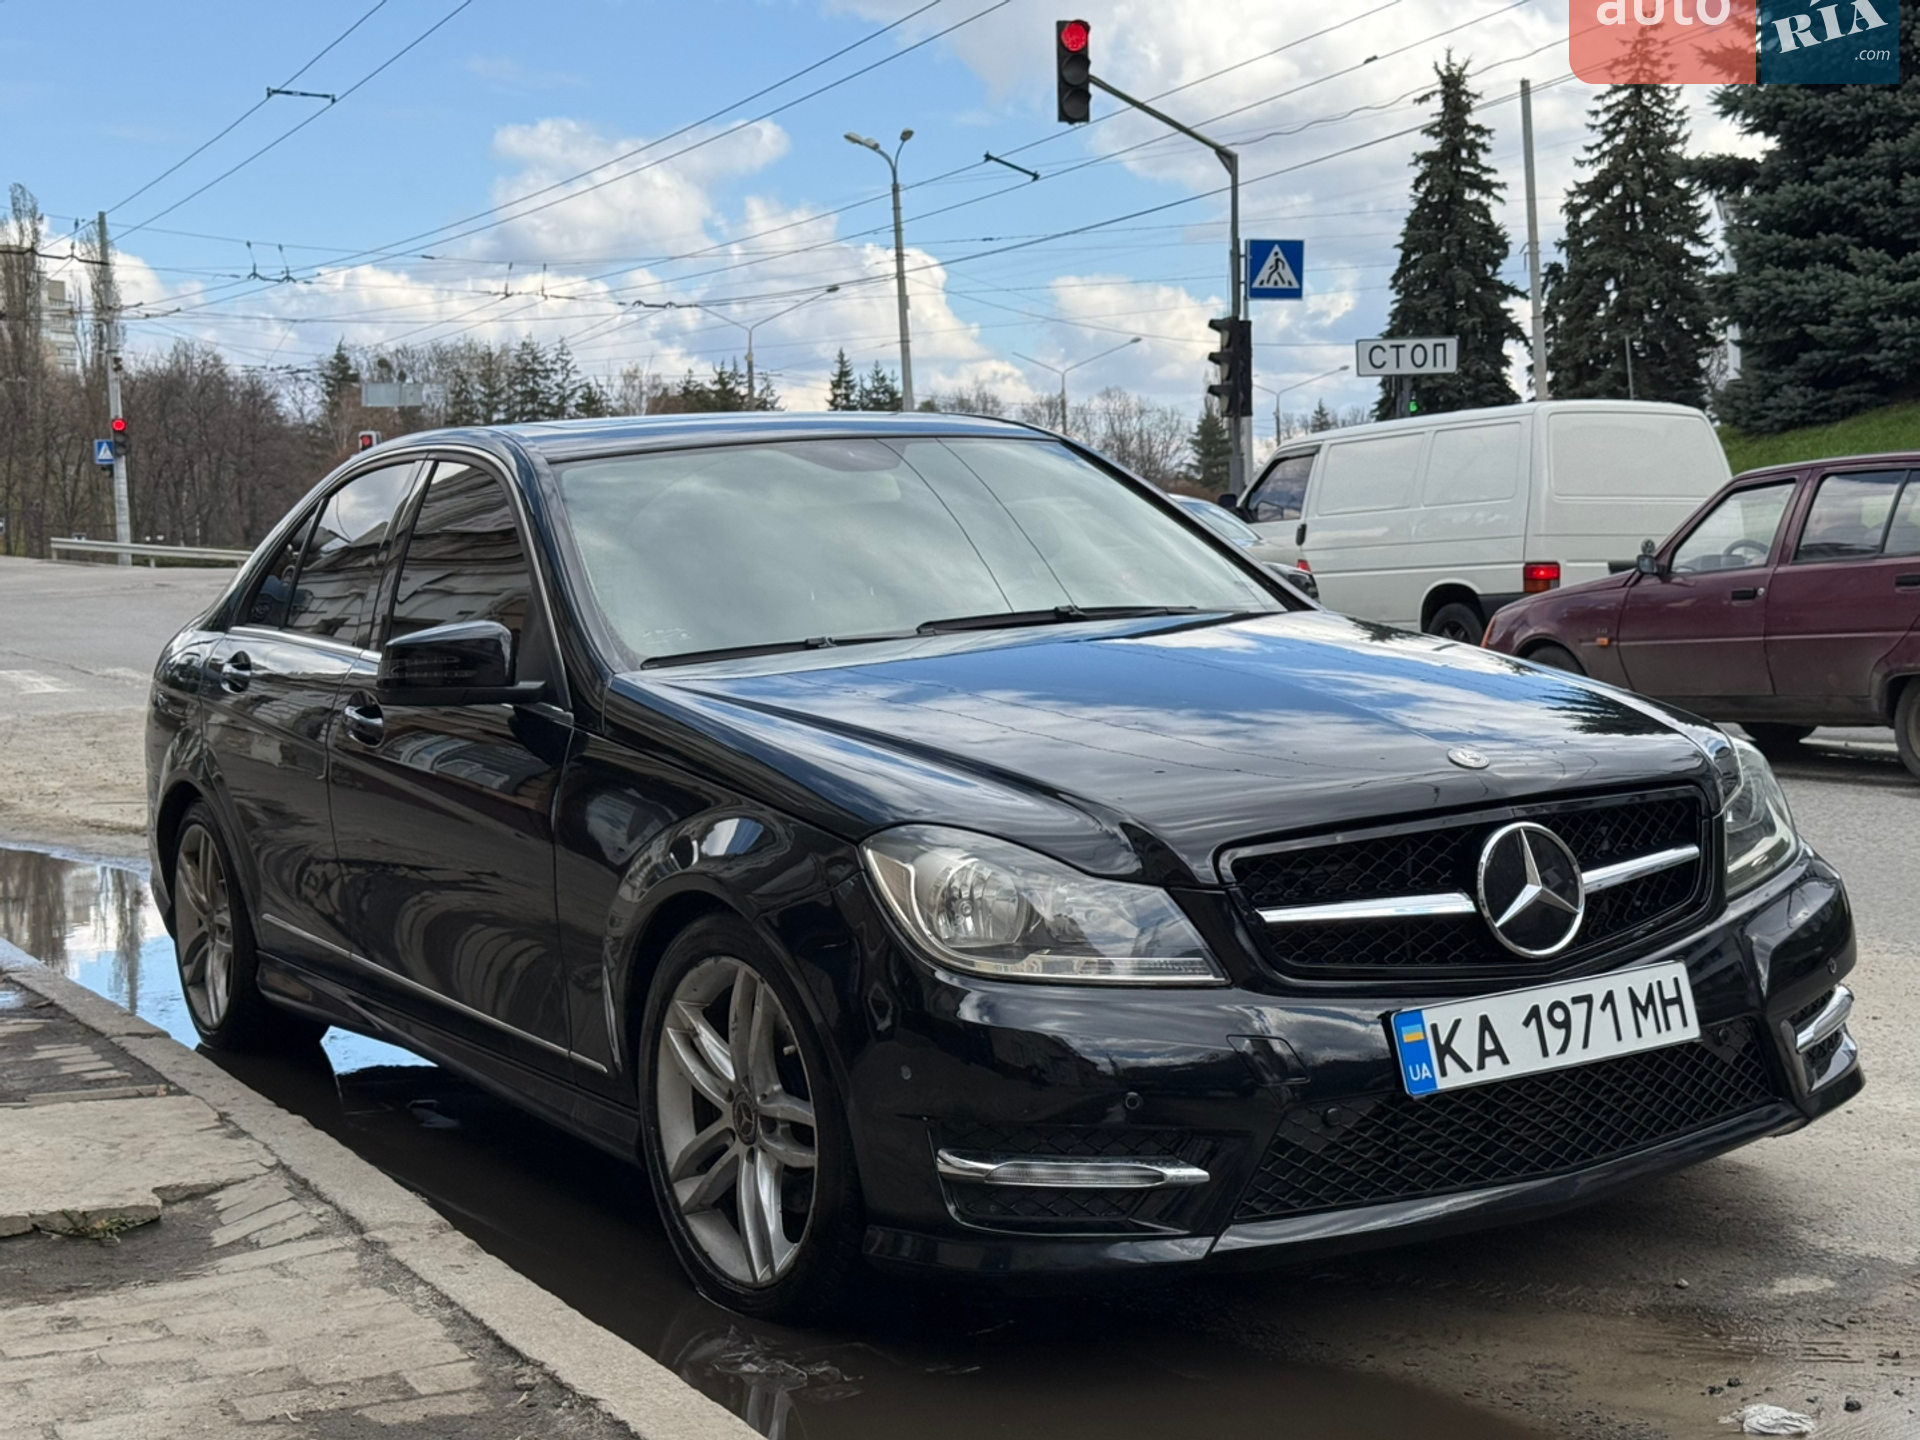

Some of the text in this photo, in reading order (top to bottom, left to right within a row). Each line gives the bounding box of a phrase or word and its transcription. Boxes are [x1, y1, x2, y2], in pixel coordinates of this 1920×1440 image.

[1368, 343, 1447, 369] СТОП
[1430, 976, 1689, 1078] KA 1971 MH
[1408, 1062, 1432, 1081] UA
